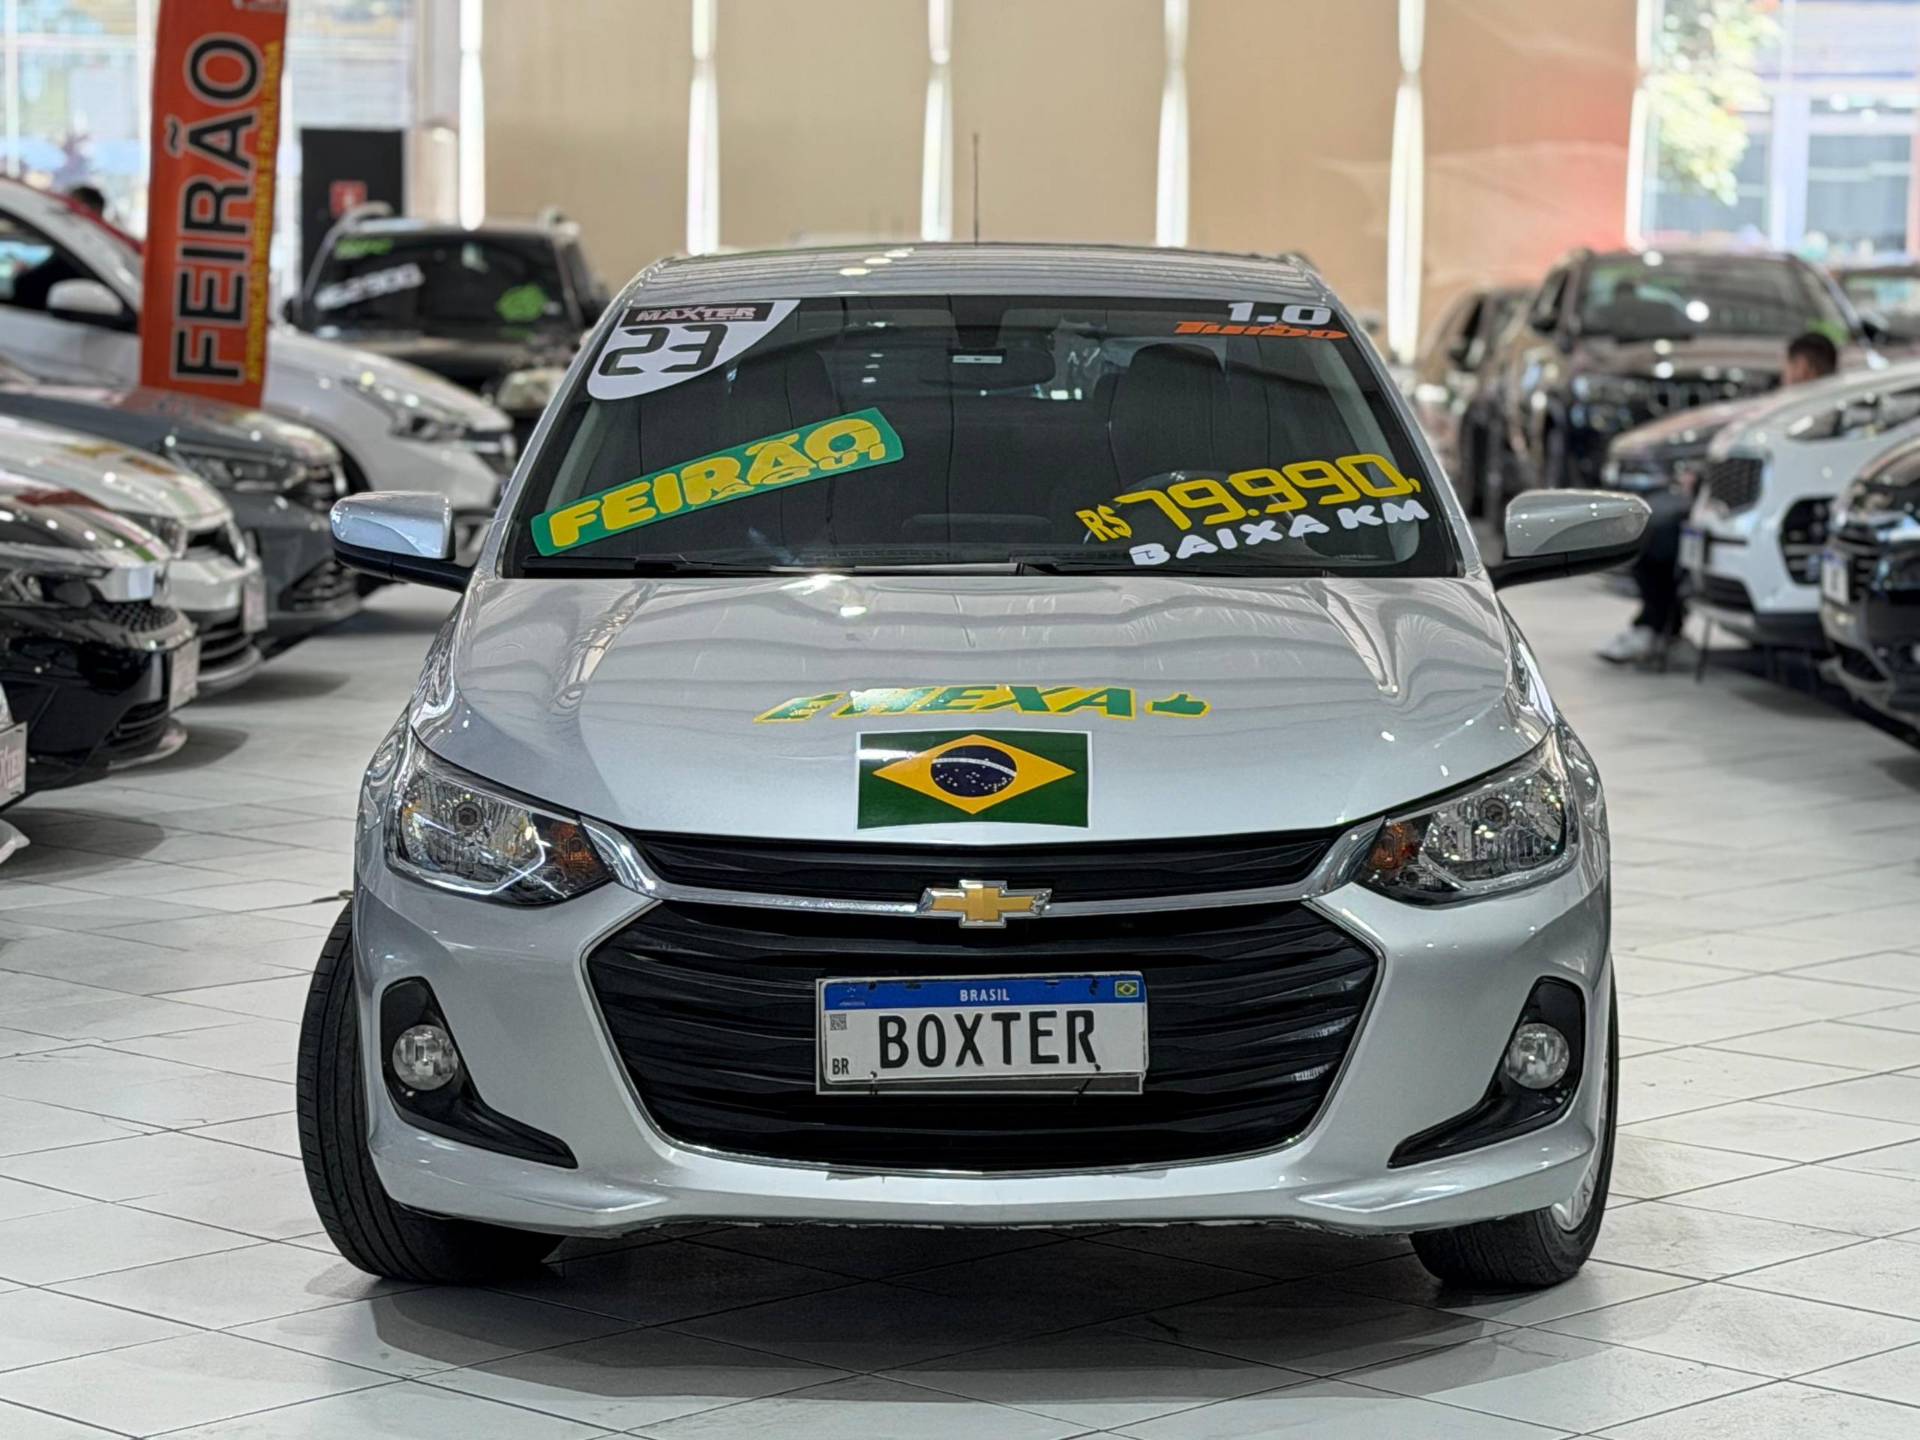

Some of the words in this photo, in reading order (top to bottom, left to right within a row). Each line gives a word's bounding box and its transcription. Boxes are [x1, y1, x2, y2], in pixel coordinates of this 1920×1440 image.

[165, 33, 263, 384] FEIRÃO
[636, 306, 757, 321] MAXTER
[1228, 302, 1332, 325] 1.0
[598, 323, 729, 377] 23
[549, 418, 881, 547] FEIRÃO
[1129, 514, 1331, 566] BAIXA
[1336, 499, 1430, 530] KM
[959, 988, 1011, 1002] BRASIL
[878, 1009, 1097, 1069] BOXTER
[832, 1057, 850, 1076] BR
